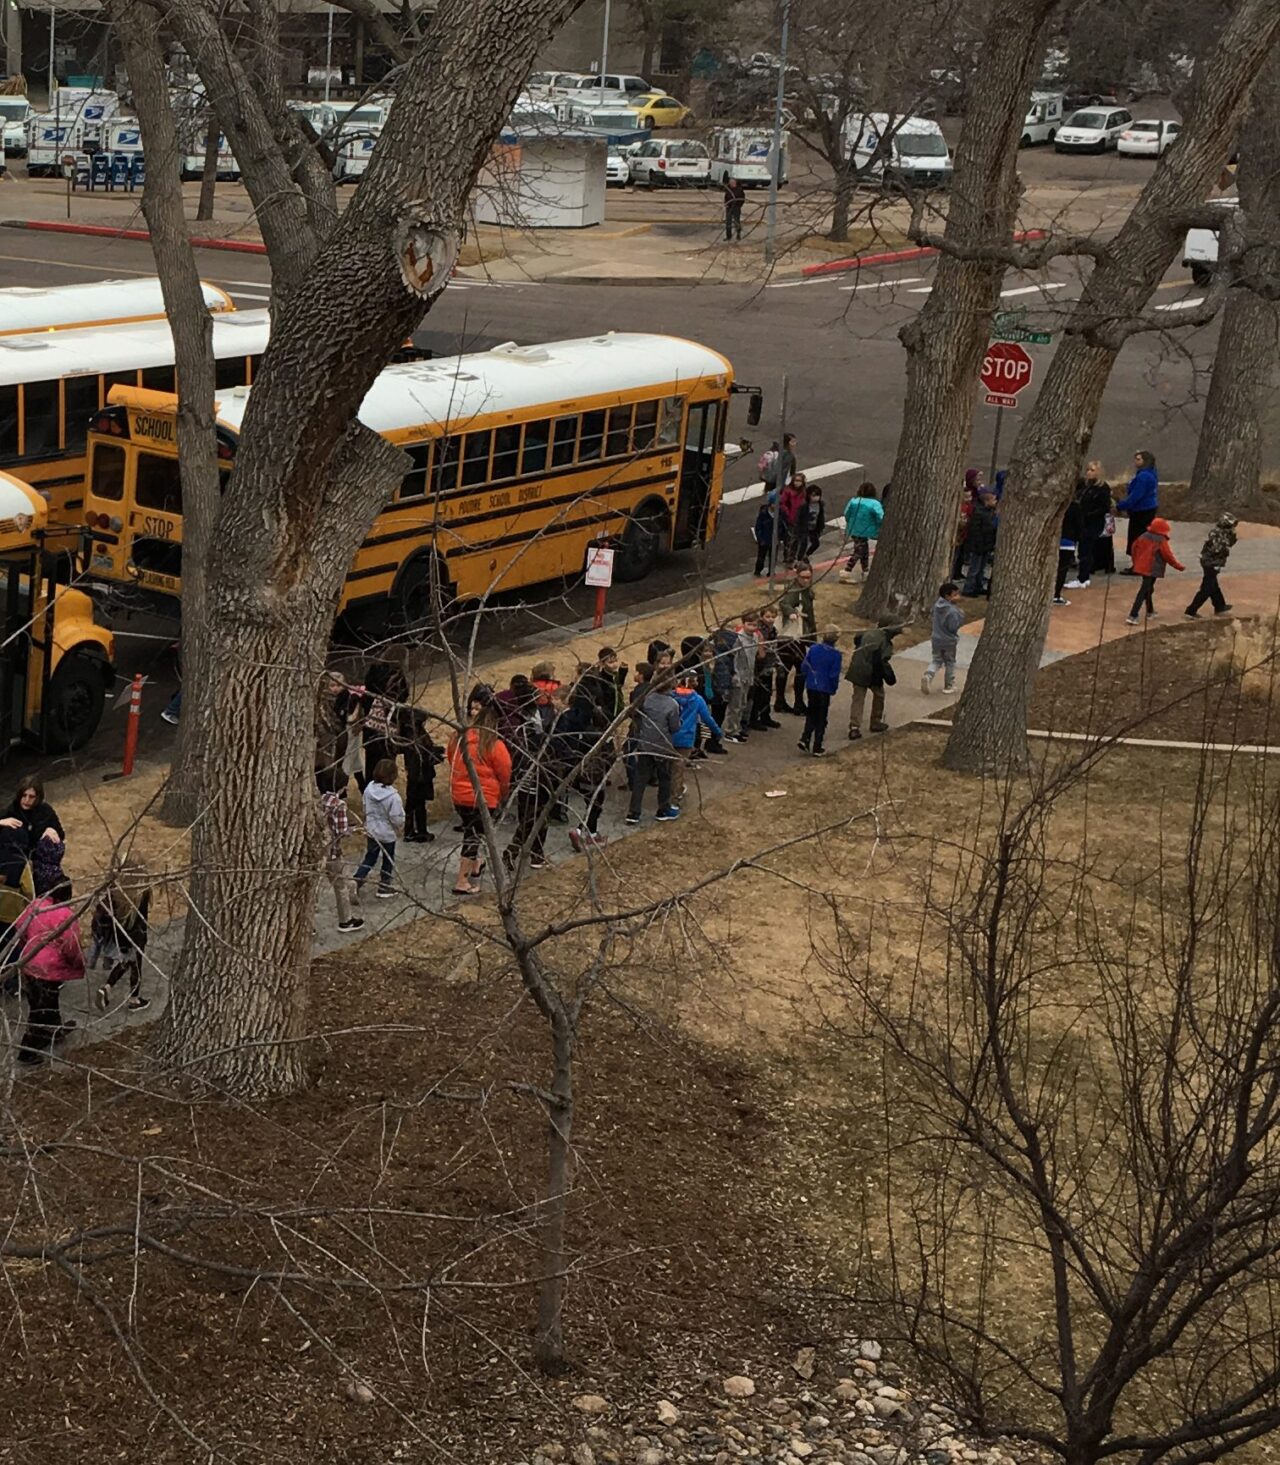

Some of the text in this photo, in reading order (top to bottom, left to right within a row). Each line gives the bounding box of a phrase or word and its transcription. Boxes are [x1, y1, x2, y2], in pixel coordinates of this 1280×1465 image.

[981, 356, 1029, 380] STOP
[987, 396, 1014, 405] ALL WAY
[134, 416, 174, 441] SCHOOL
[458, 484, 543, 516] POUDRE SCHOOL DISTRICT
[144, 516, 174, 539] STOP
